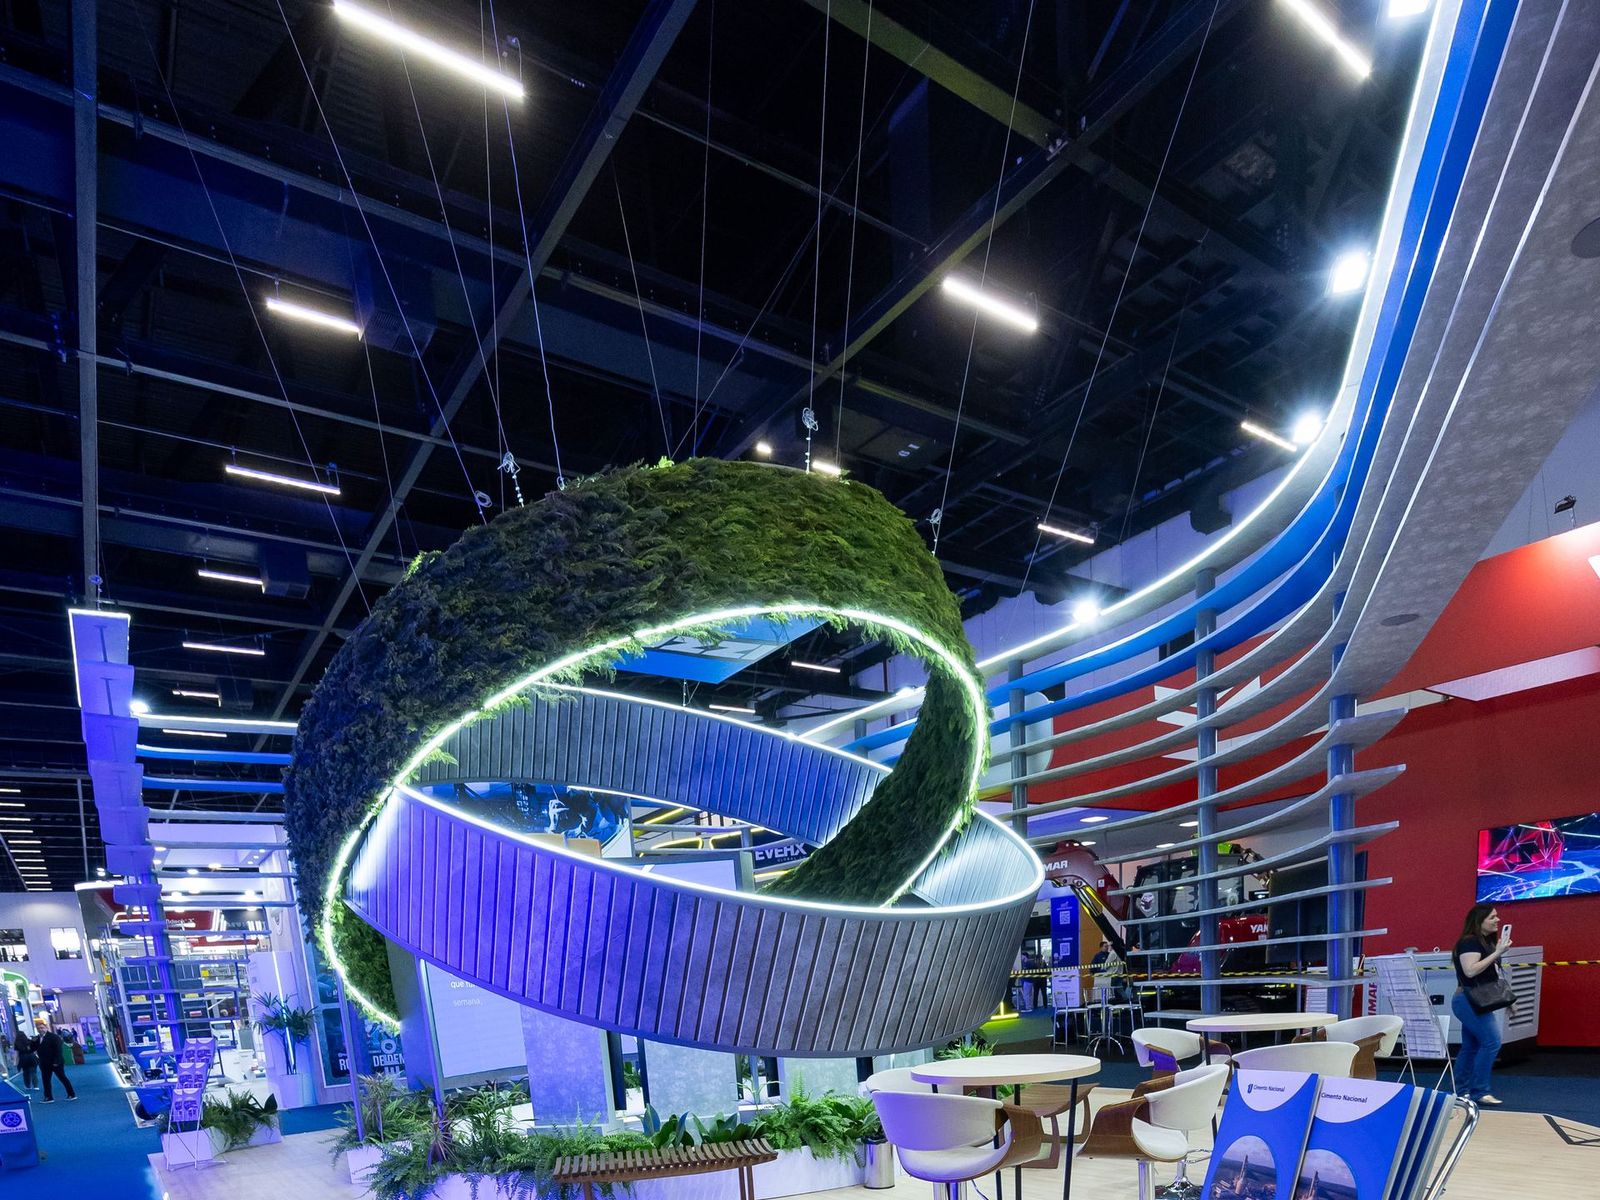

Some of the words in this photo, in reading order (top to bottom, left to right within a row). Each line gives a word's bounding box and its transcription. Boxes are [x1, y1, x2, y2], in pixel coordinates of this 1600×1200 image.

[1268, 1085, 1285, 1093] Nacional
[1321, 1092, 1341, 1100] Cimento
[1342, 1094, 1368, 1104] Nacional
